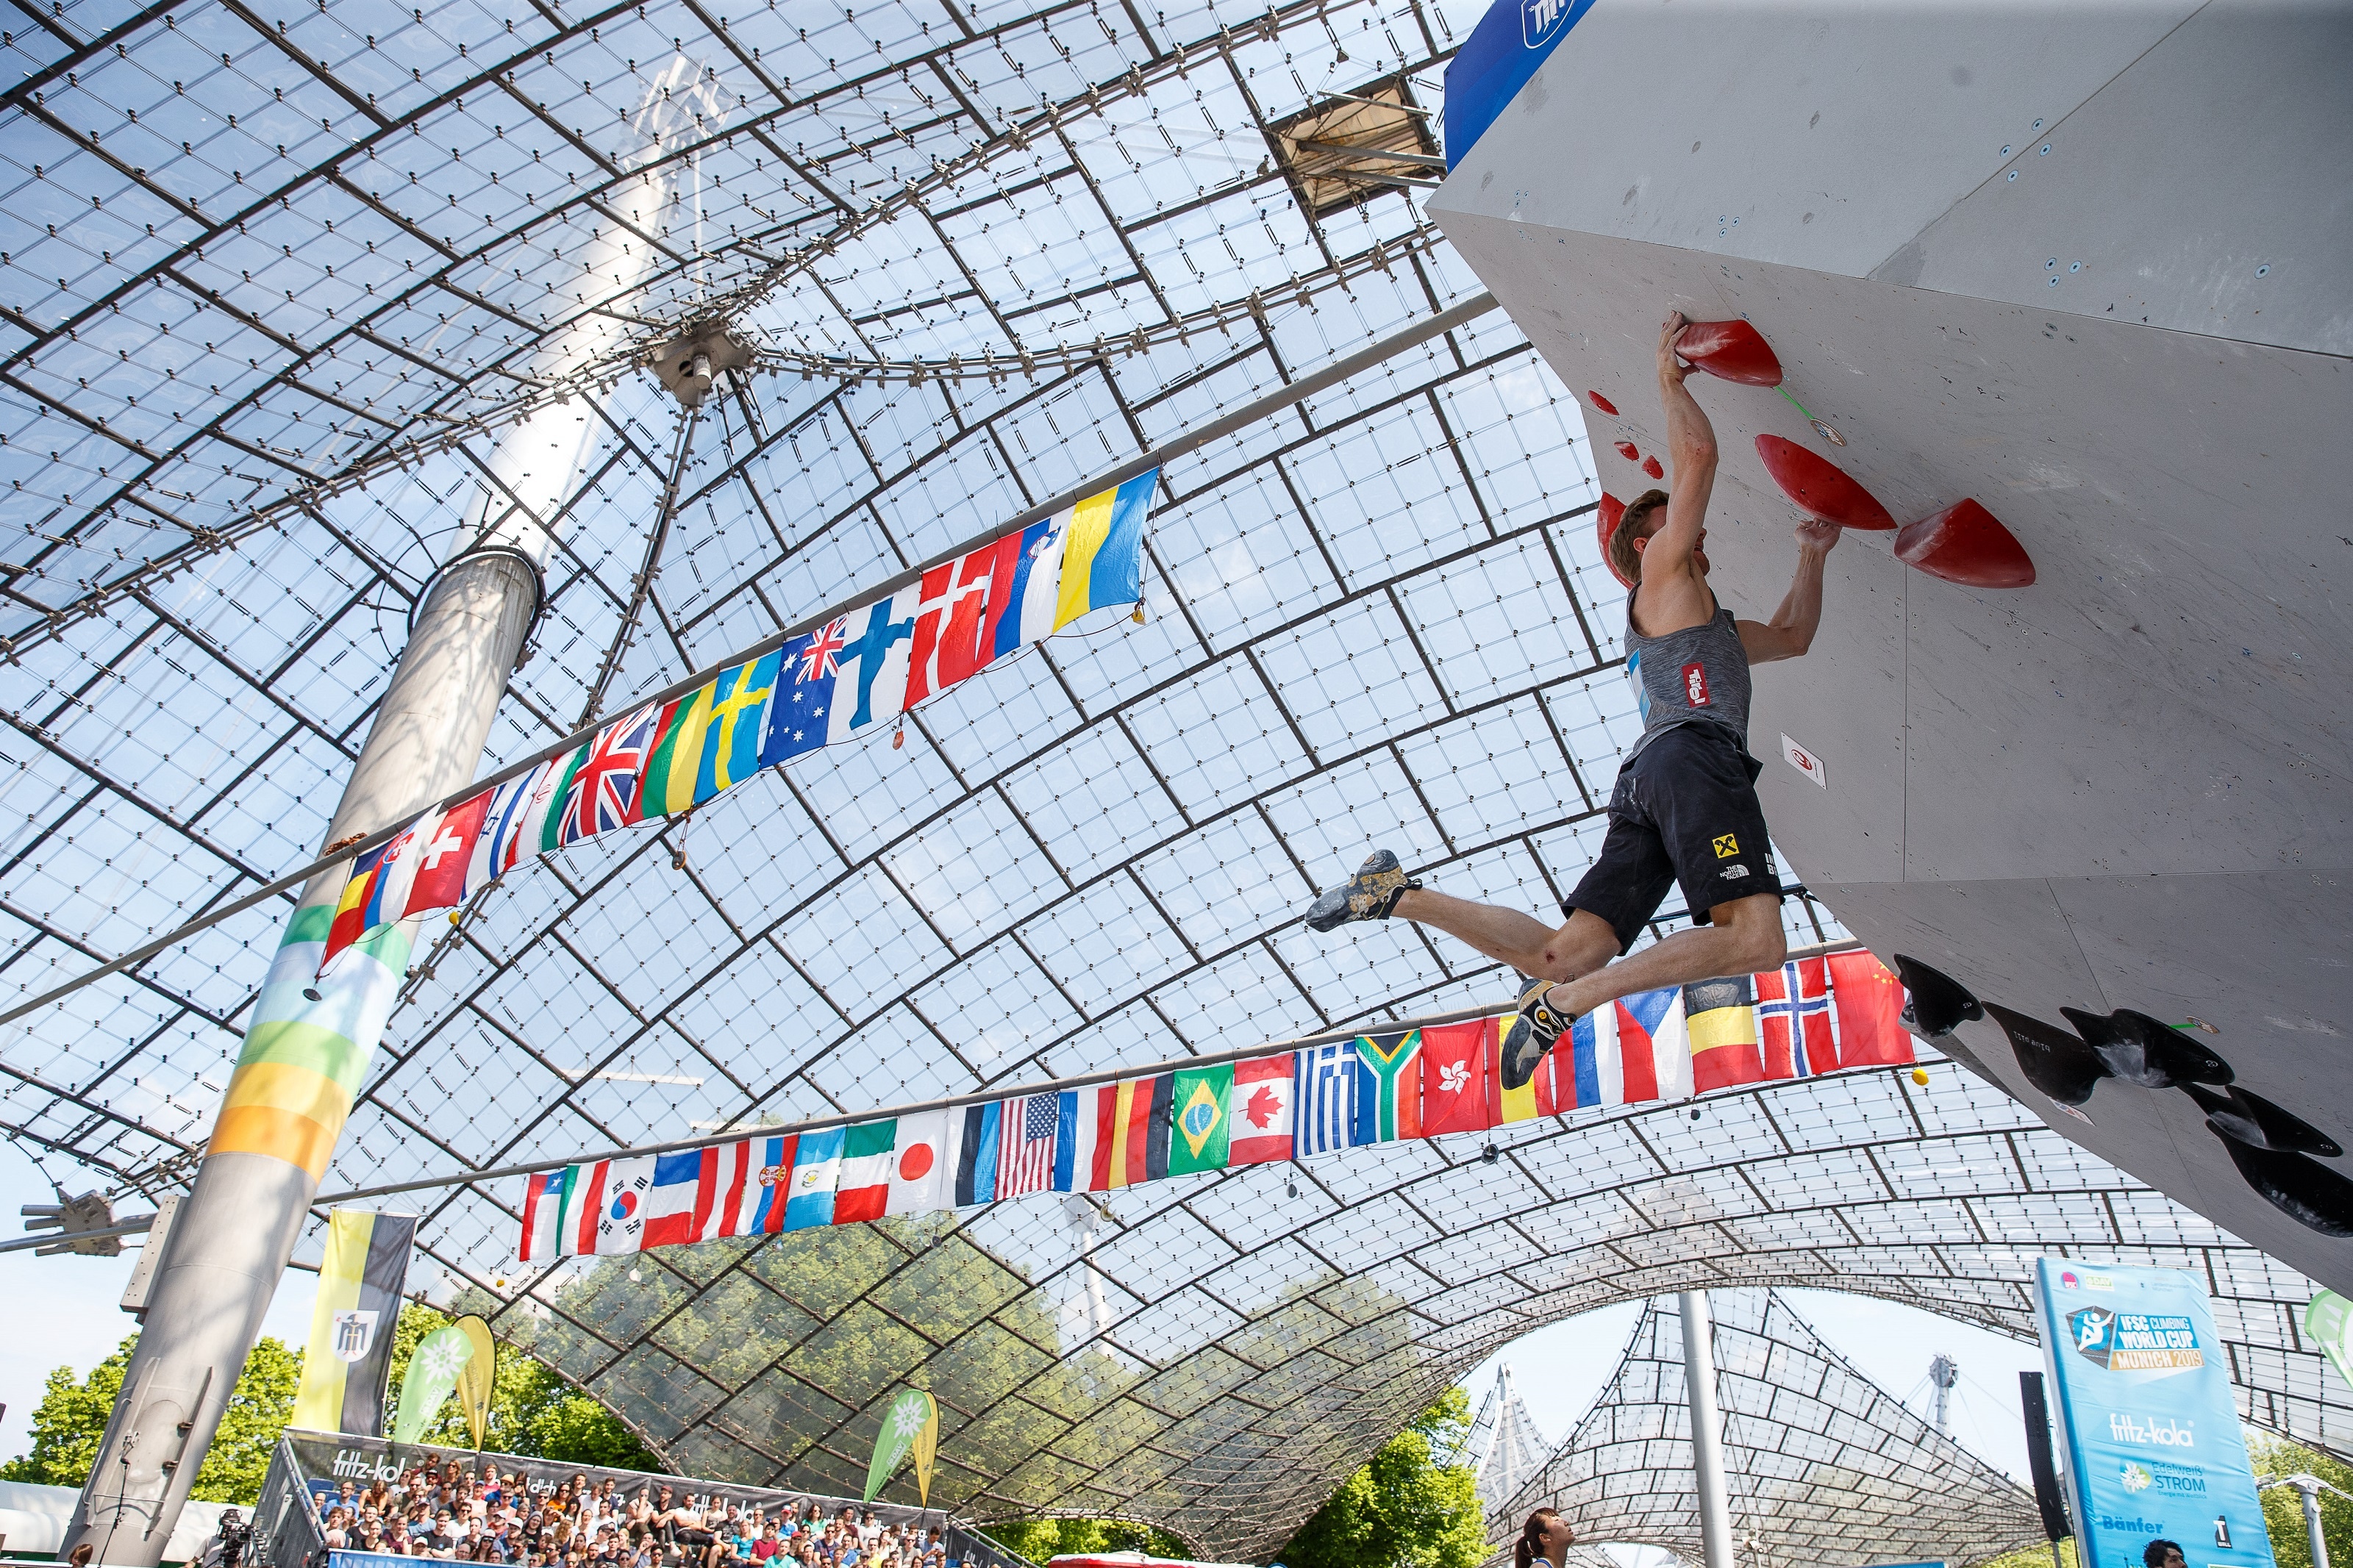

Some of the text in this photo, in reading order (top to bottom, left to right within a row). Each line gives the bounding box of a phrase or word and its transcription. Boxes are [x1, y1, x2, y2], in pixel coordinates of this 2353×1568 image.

[1689, 669, 1706, 704] Tirol
[1720, 870, 1738, 878] NORTH
[2031, 1039, 2051, 1053] blue
[2120, 1315, 2190, 1331] IFSC CLIMBING
[2118, 1331, 2193, 1349] WORLD CUP
[2116, 1350, 2204, 1369] MUNICH 2019
[2109, 1413, 2194, 1447] fritz-kola
[332, 1449, 406, 1483] fritz-kol
[2152, 1462, 2203, 1476] Edelweiß
[2155, 1475, 2206, 1492] STROM
[2102, 1516, 2163, 1534] Bänfer
